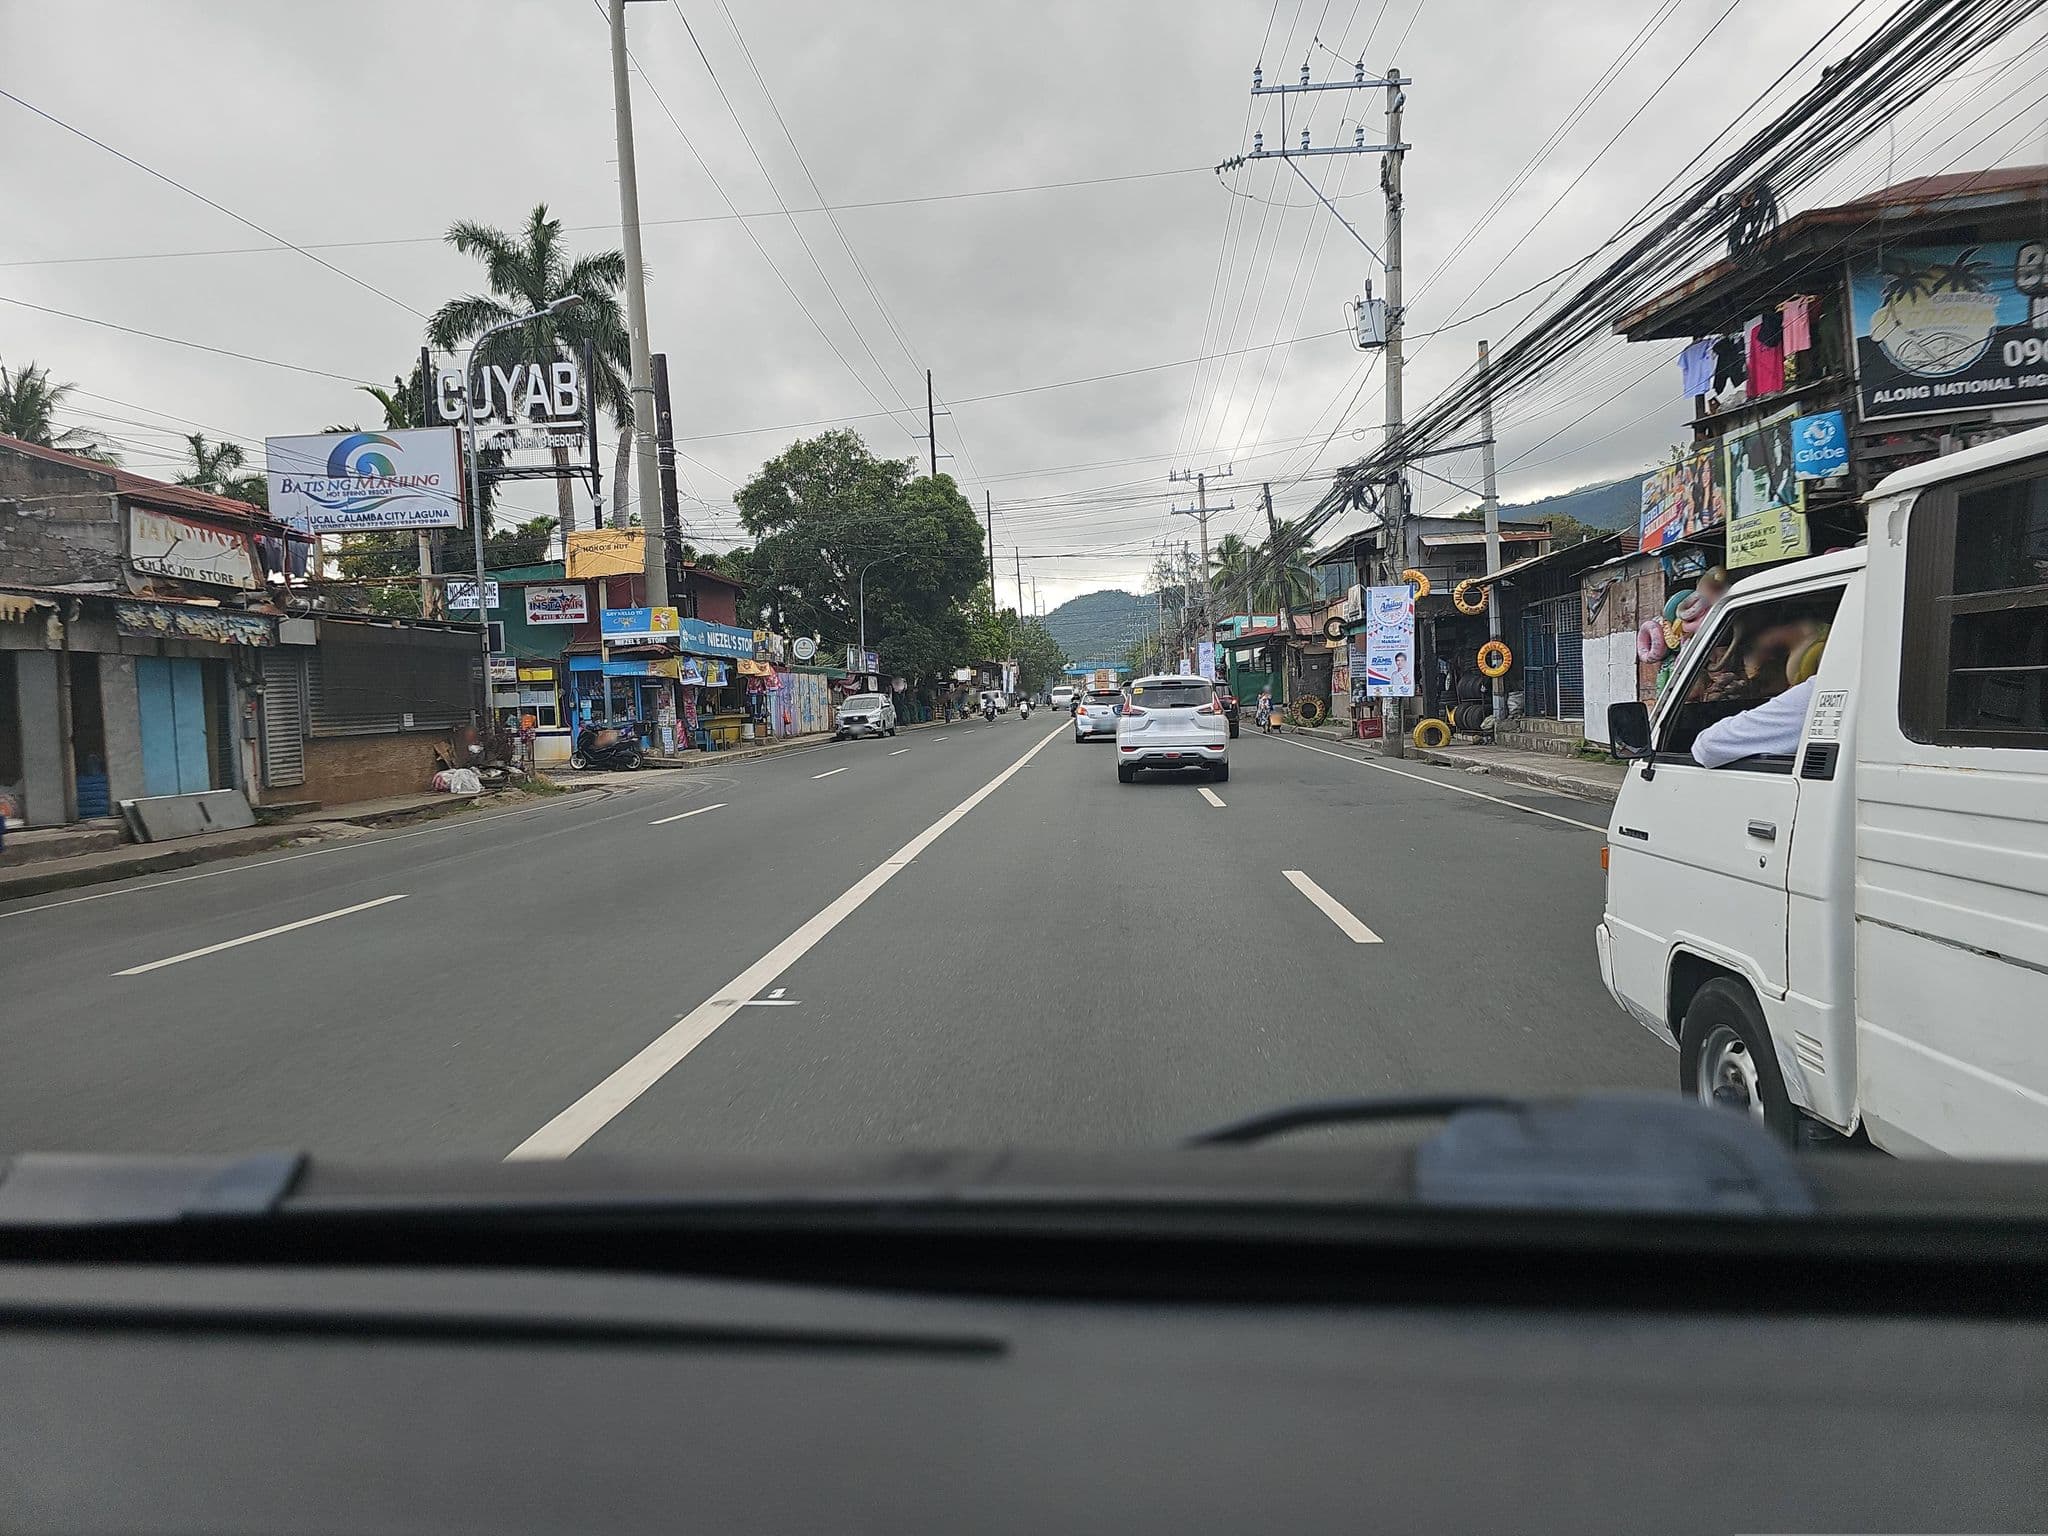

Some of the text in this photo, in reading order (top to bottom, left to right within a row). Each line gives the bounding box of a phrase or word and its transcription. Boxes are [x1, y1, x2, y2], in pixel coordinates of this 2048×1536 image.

[1872, 385, 1931, 404] ALONG
[1933, 376, 2016, 397] NATIONAL
[549, 433, 582, 447] RESORT
[1795, 446, 1846, 463] Globe
[281, 474, 440, 494] BATIS NG MAKILING
[306, 515, 335, 525] UCAL
[336, 512, 384, 524] CALAMBA
[384, 511, 407, 521] CITY
[408, 509, 450, 520] LAGUNA
[200, 569, 235, 585] STORE
[448, 584, 459, 598] NO
[472, 597, 496, 607] PRERTY
[707, 631, 738, 650] NIEZEL'S
